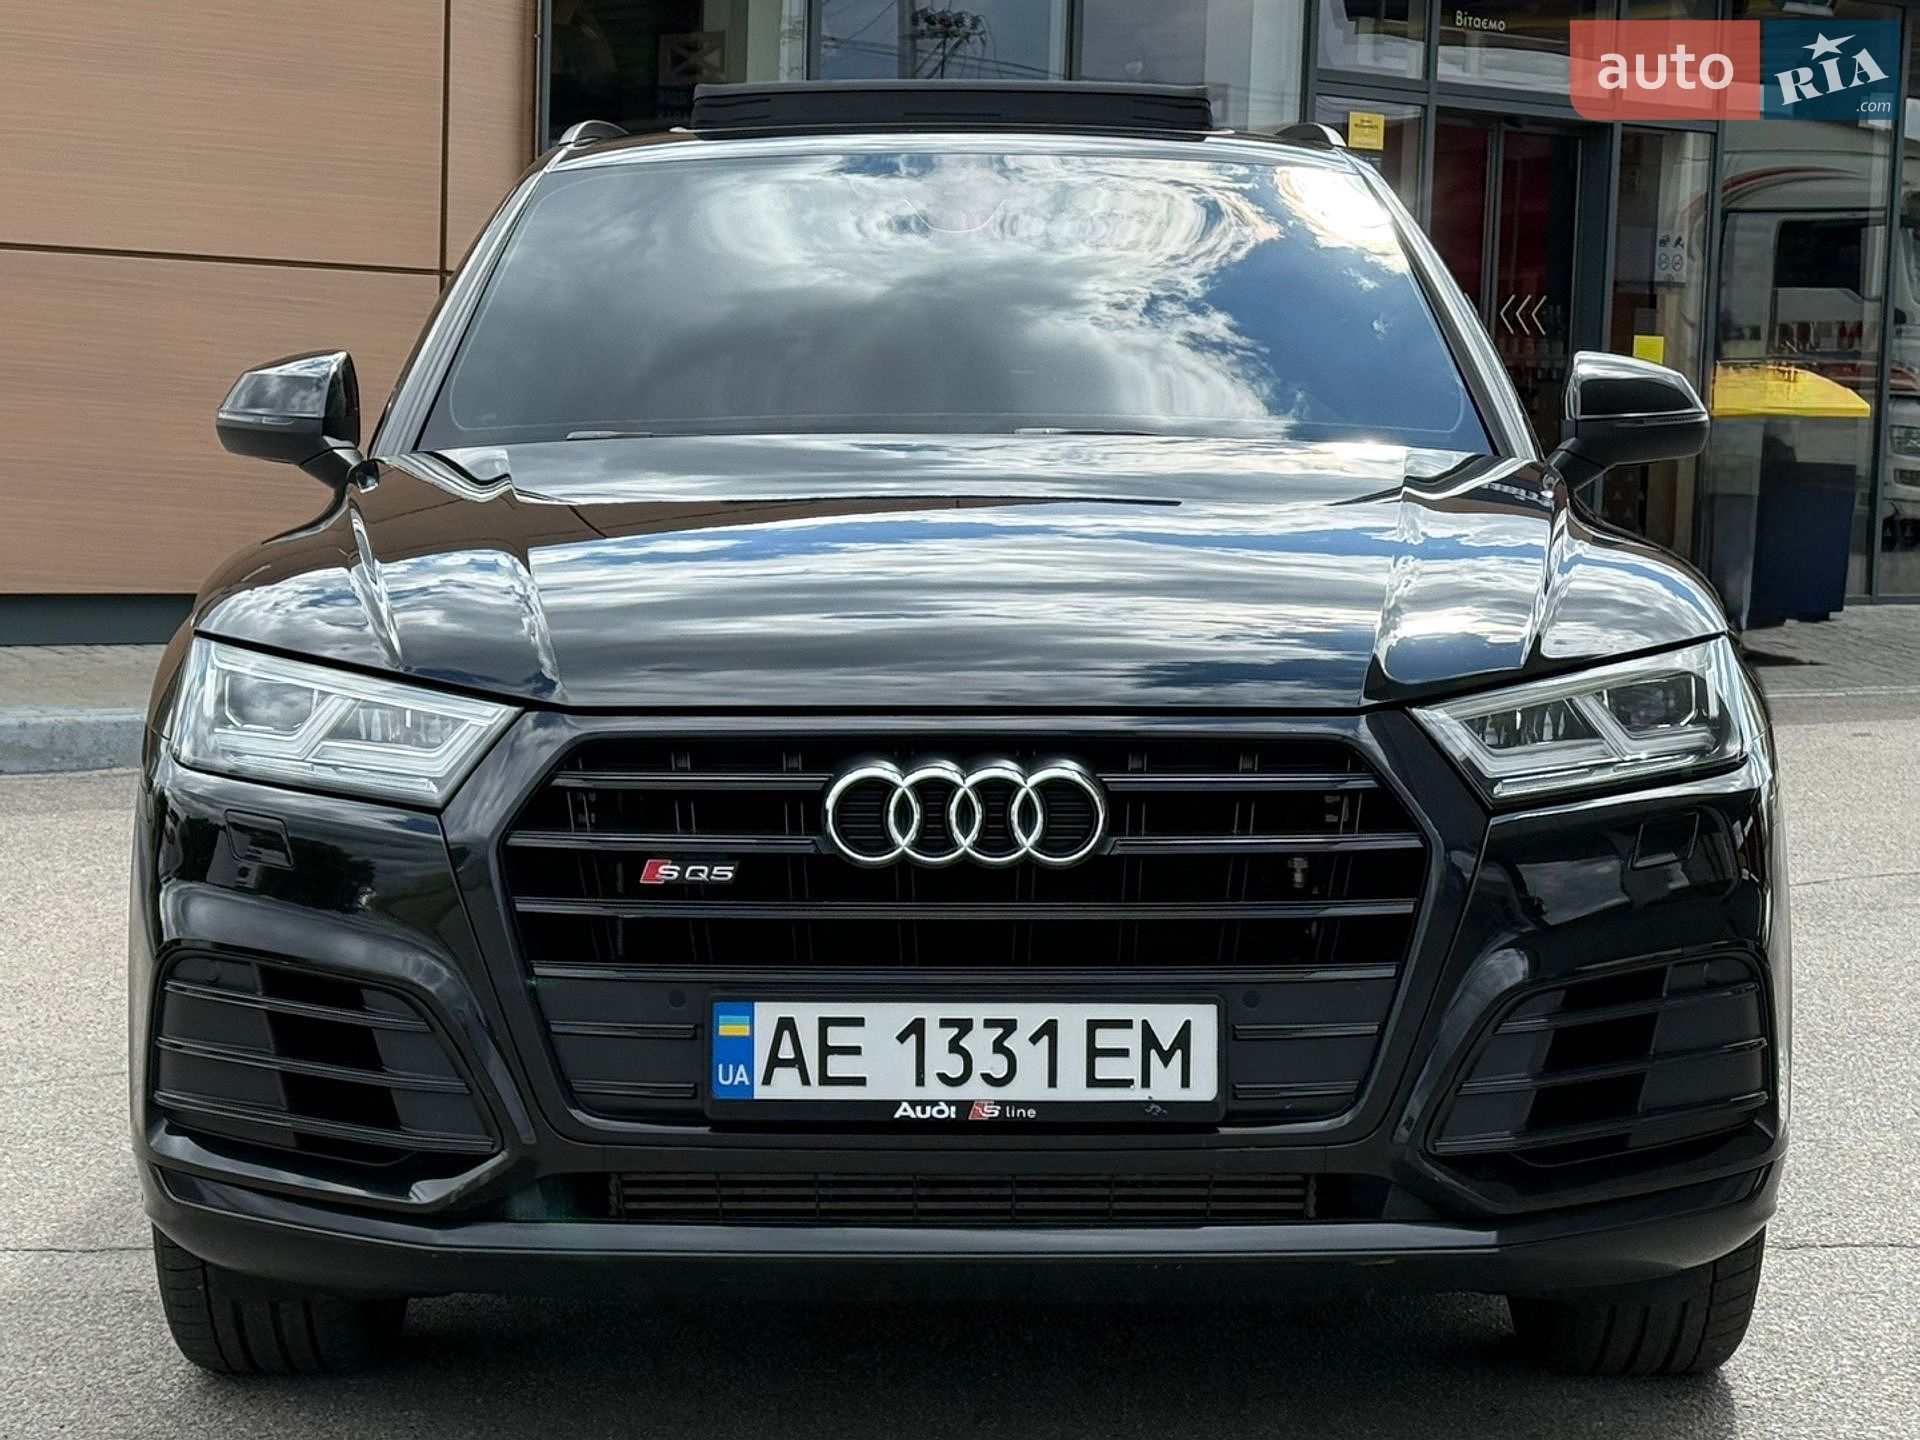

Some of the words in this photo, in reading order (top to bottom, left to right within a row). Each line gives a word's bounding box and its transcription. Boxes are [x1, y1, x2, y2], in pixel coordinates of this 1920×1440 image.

[1456, 10, 1505, 31] Вітаємо
[650, 863, 735, 882] SQ5
[761, 1016, 867, 1086] AE
[895, 1017, 1058, 1088] 1331
[1085, 1019, 1192, 1088] EM
[718, 1065, 749, 1085] UA
[893, 1101, 956, 1119] Audi
[1006, 1105, 1036, 1118] line
